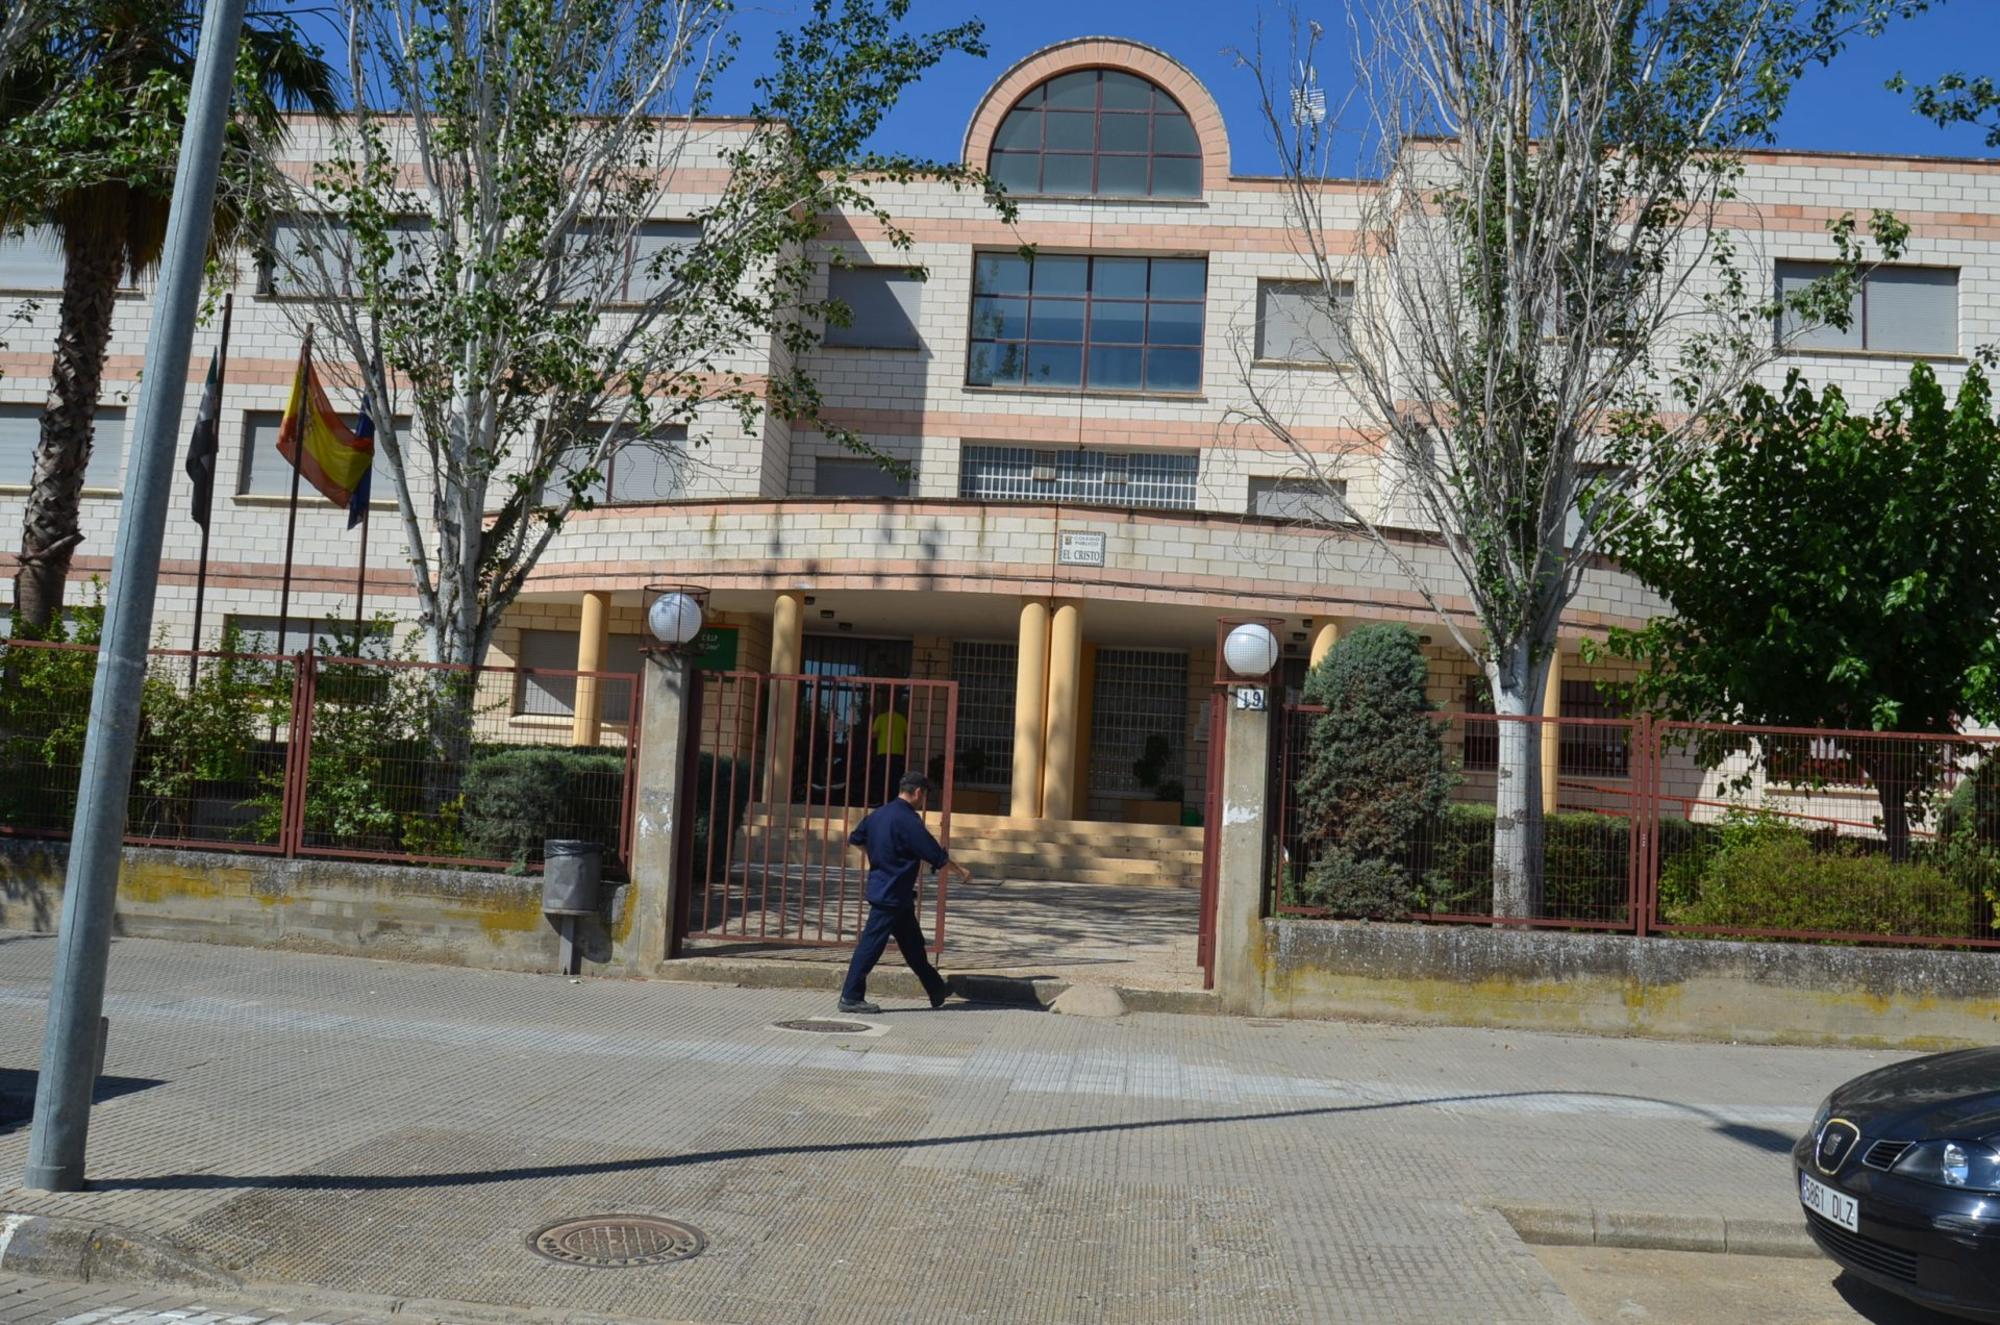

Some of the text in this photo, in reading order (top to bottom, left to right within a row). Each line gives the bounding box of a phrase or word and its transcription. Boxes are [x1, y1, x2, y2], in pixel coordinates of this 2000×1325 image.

[1063, 549, 1100, 561] EL CRISTO
[1243, 691, 1261, 707] 19
[1832, 1194, 1854, 1226] DLZ
